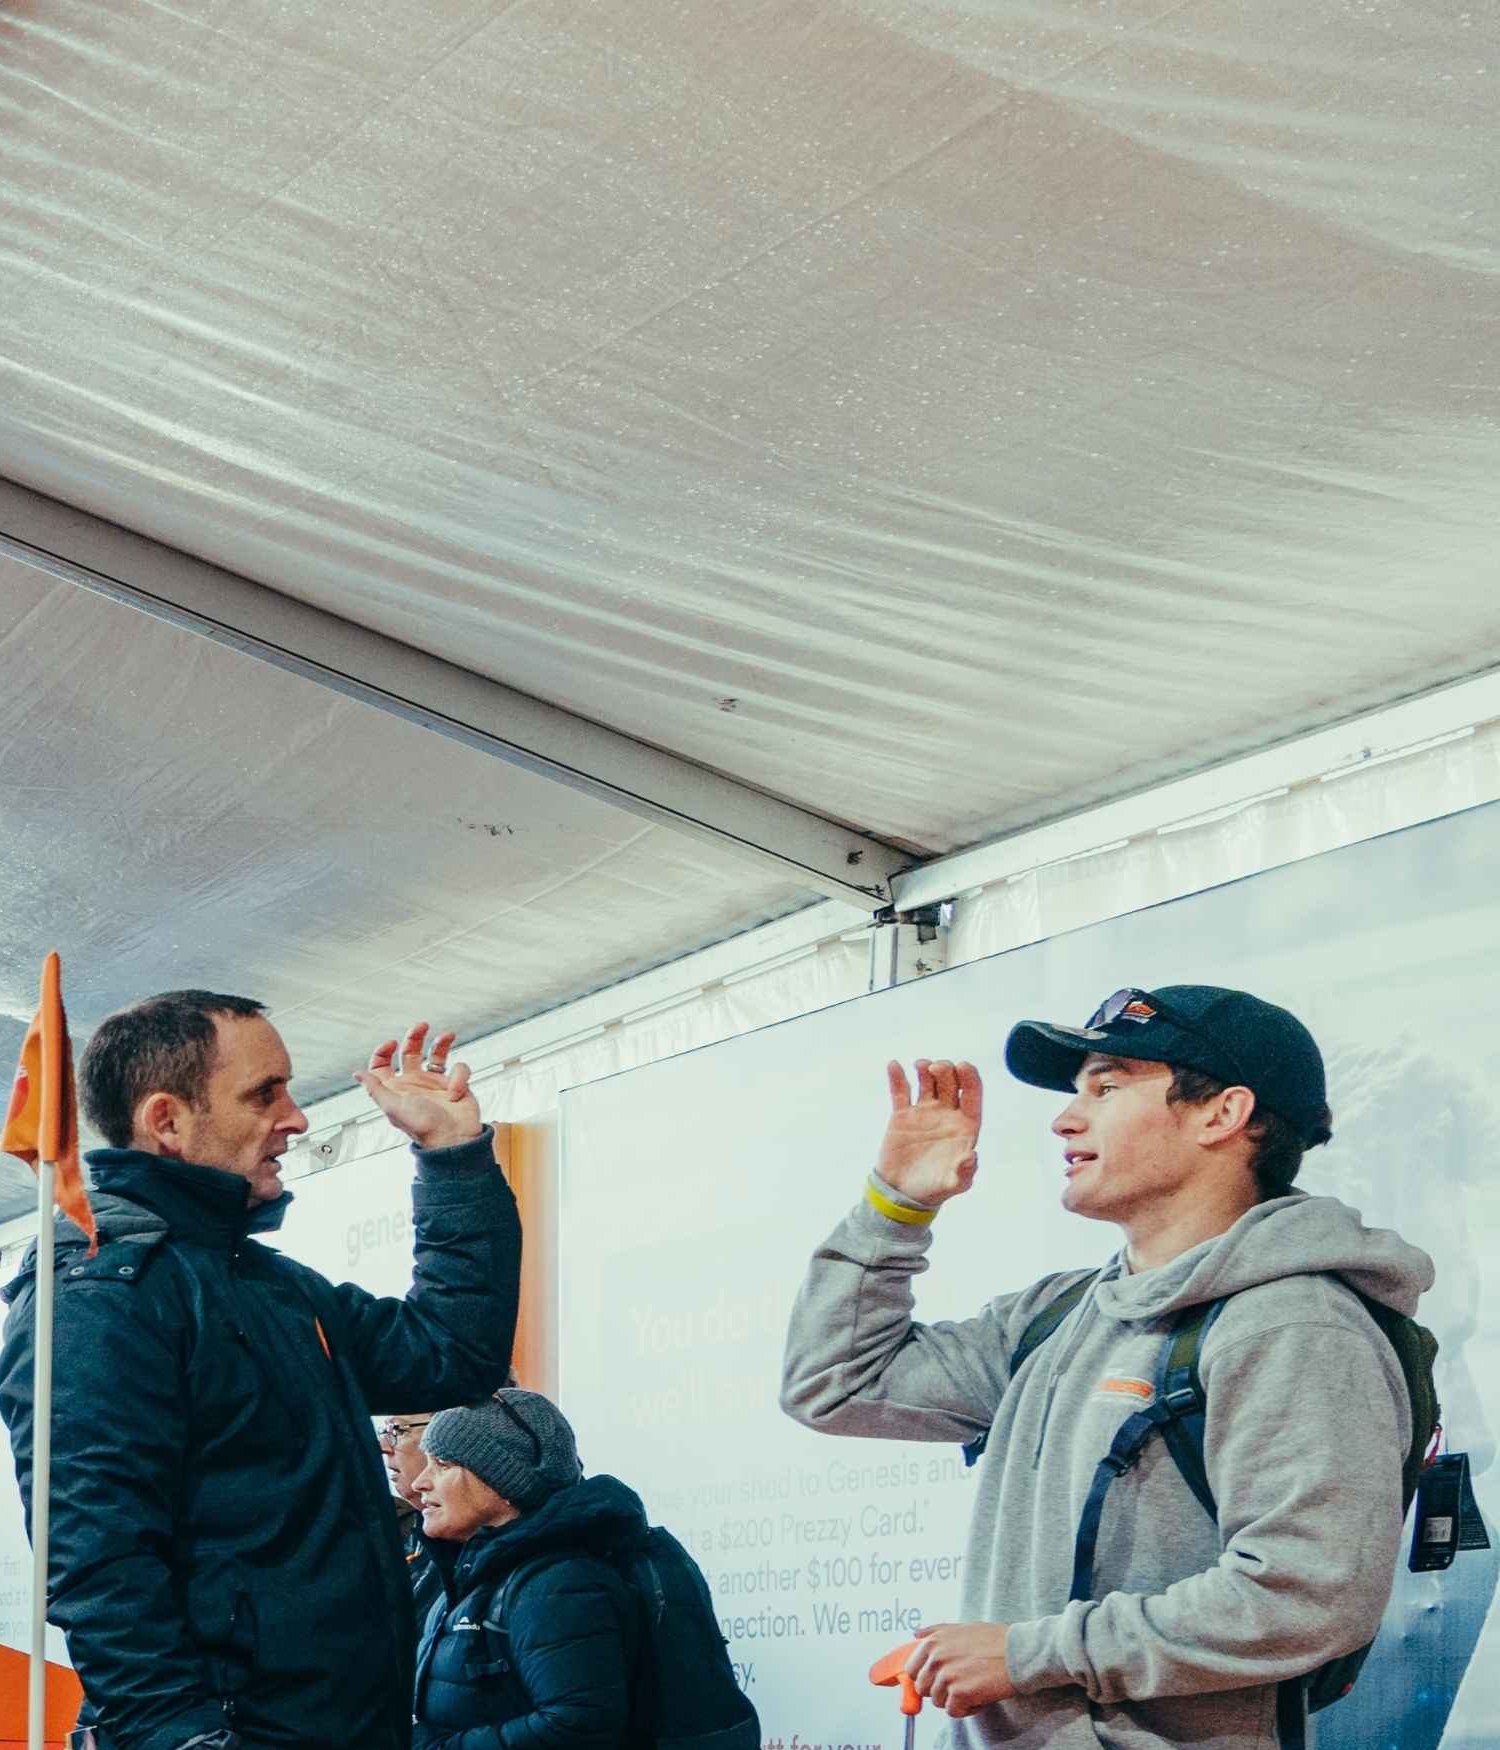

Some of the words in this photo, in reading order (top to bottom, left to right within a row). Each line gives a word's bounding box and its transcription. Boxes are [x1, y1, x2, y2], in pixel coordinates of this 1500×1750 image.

[346, 1209, 413, 1268] gene
[828, 1452, 921, 1494] Genesis
[717, 1514, 774, 1556] $200
[780, 1510, 853, 1550] Prezzy
[719, 1558, 801, 1596] another
[807, 1554, 862, 1593] $100
[869, 1551, 903, 1585] for
[908, 1554, 963, 1584] ever
[720, 1606, 805, 1640] nection.
[812, 1602, 851, 1636] We
[858, 1598, 923, 1635] make
